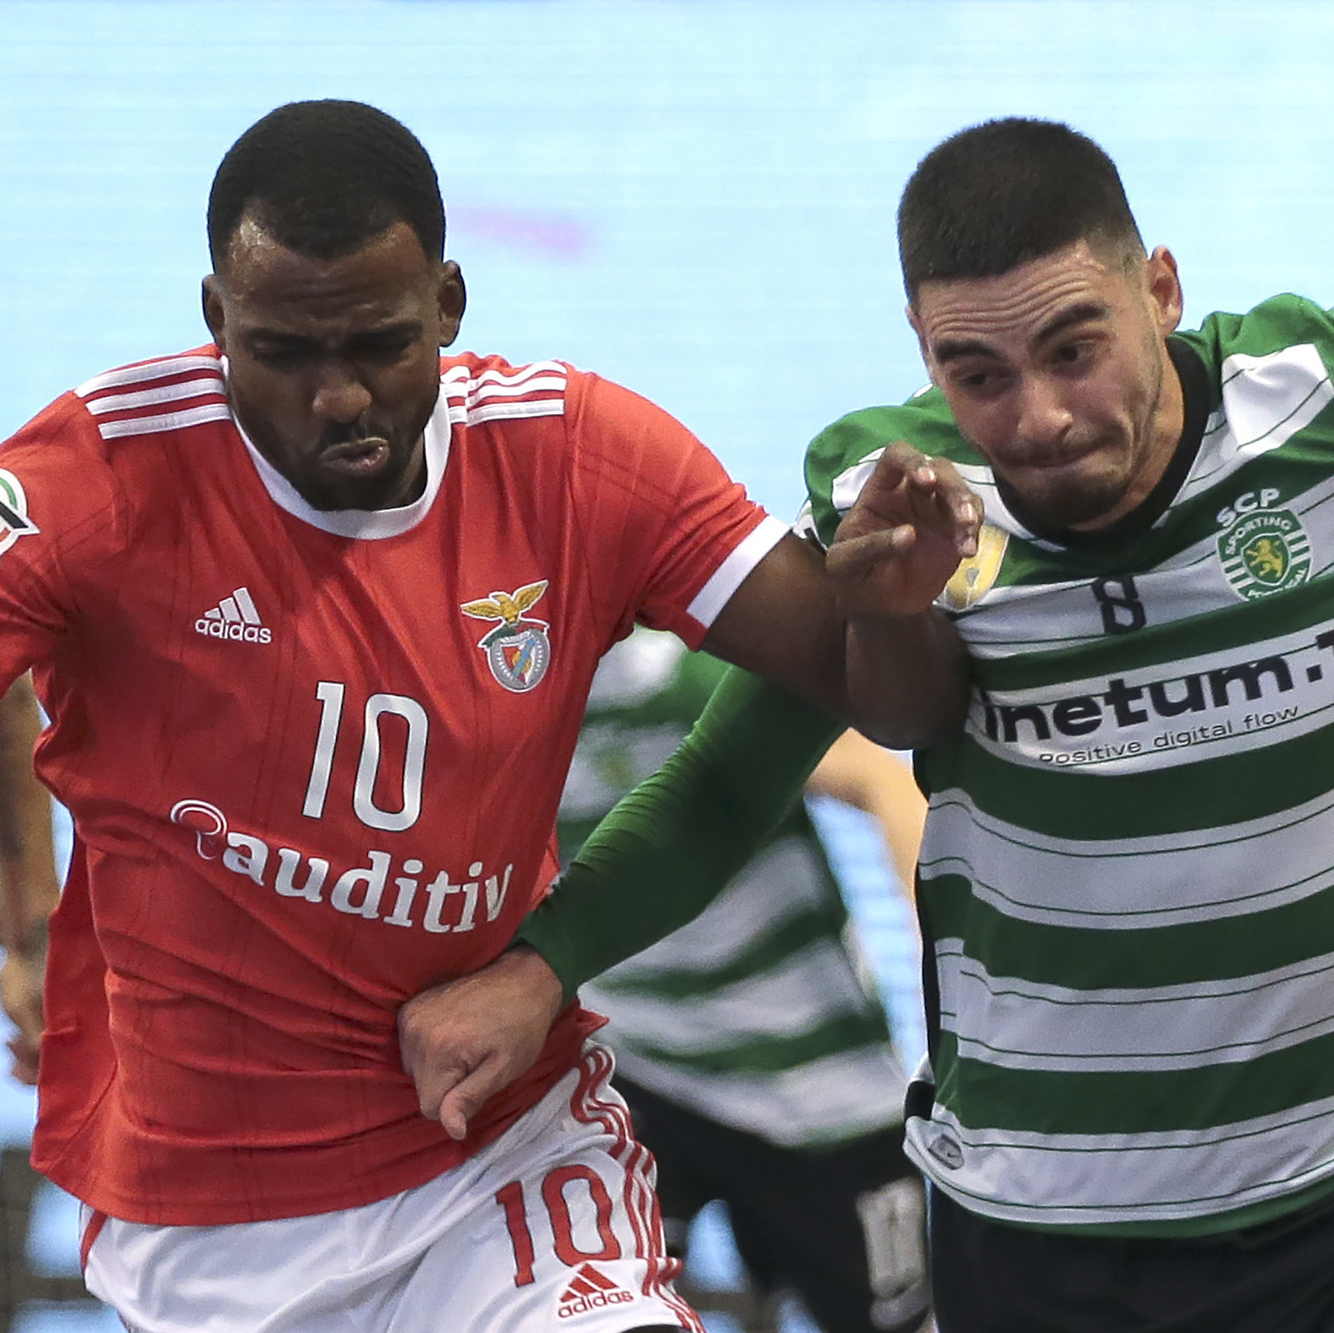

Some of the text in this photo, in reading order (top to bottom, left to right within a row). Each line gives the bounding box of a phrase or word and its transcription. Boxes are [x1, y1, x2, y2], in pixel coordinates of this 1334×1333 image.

[1216, 488, 1280, 528] SCP
[1225, 515, 1293, 555] SPORTING
[1092, 574, 1146, 634] 8
[195, 617, 273, 645] adidas
[302, 680, 430, 833] 10
[1040, 703, 1301, 766] Positive digital flow
[495, 1164, 622, 1288] 10
[557, 1289, 635, 1319] adidas
